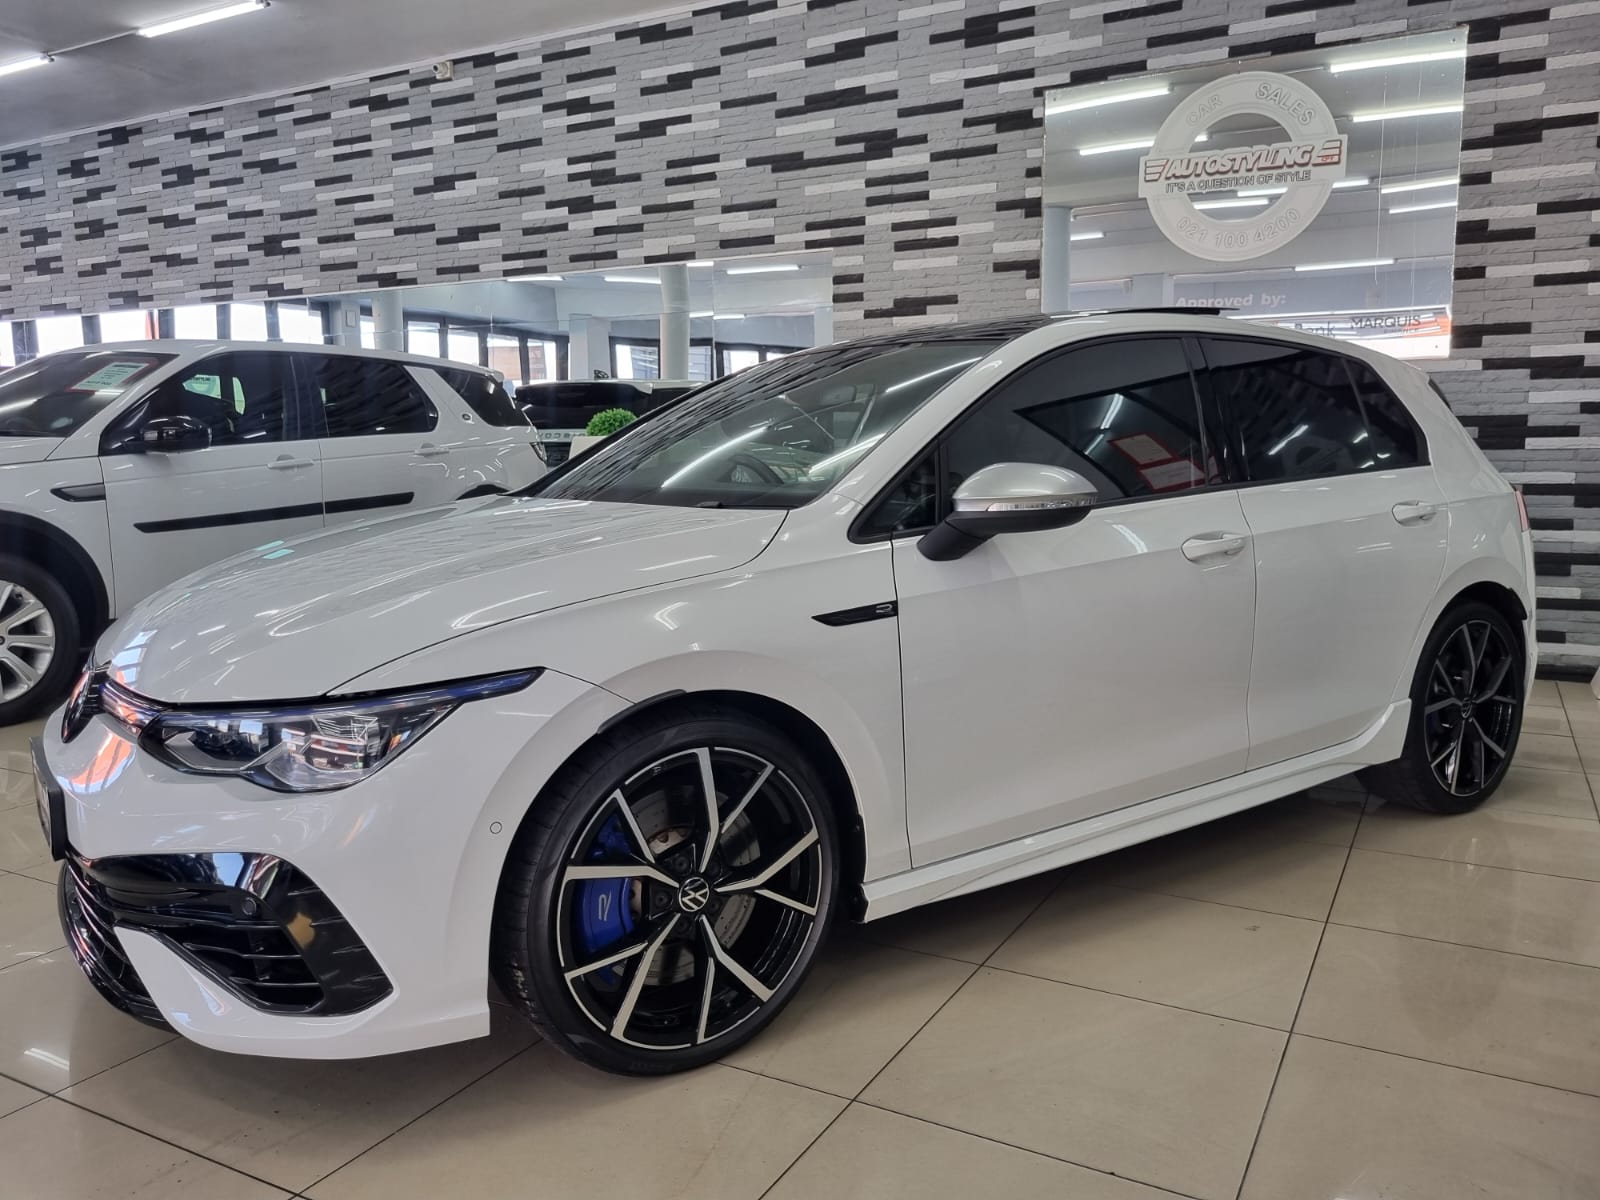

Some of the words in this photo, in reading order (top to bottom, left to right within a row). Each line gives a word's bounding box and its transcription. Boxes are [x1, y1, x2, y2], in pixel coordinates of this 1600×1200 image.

[1186, 95, 1222, 126] CAR
[1256, 82, 1315, 125] SALES
[1165, 145, 1315, 180] AUTOSTYLING
[1166, 182, 1185, 193] IT'S
[1187, 181, 1196, 192] A
[1198, 176, 1255, 191] QUESTION
[1257, 174, 1273, 185] OF
[1275, 170, 1312, 184] STYLE
[1177, 217, 1208, 241] 021
[1216, 231, 1248, 249] 100
[1254, 207, 1299, 241] 4200
[1175, 294, 1254, 307] Approved
[1261, 293, 1287, 307] by:
[1351, 315, 1421, 329] MARQUIS
